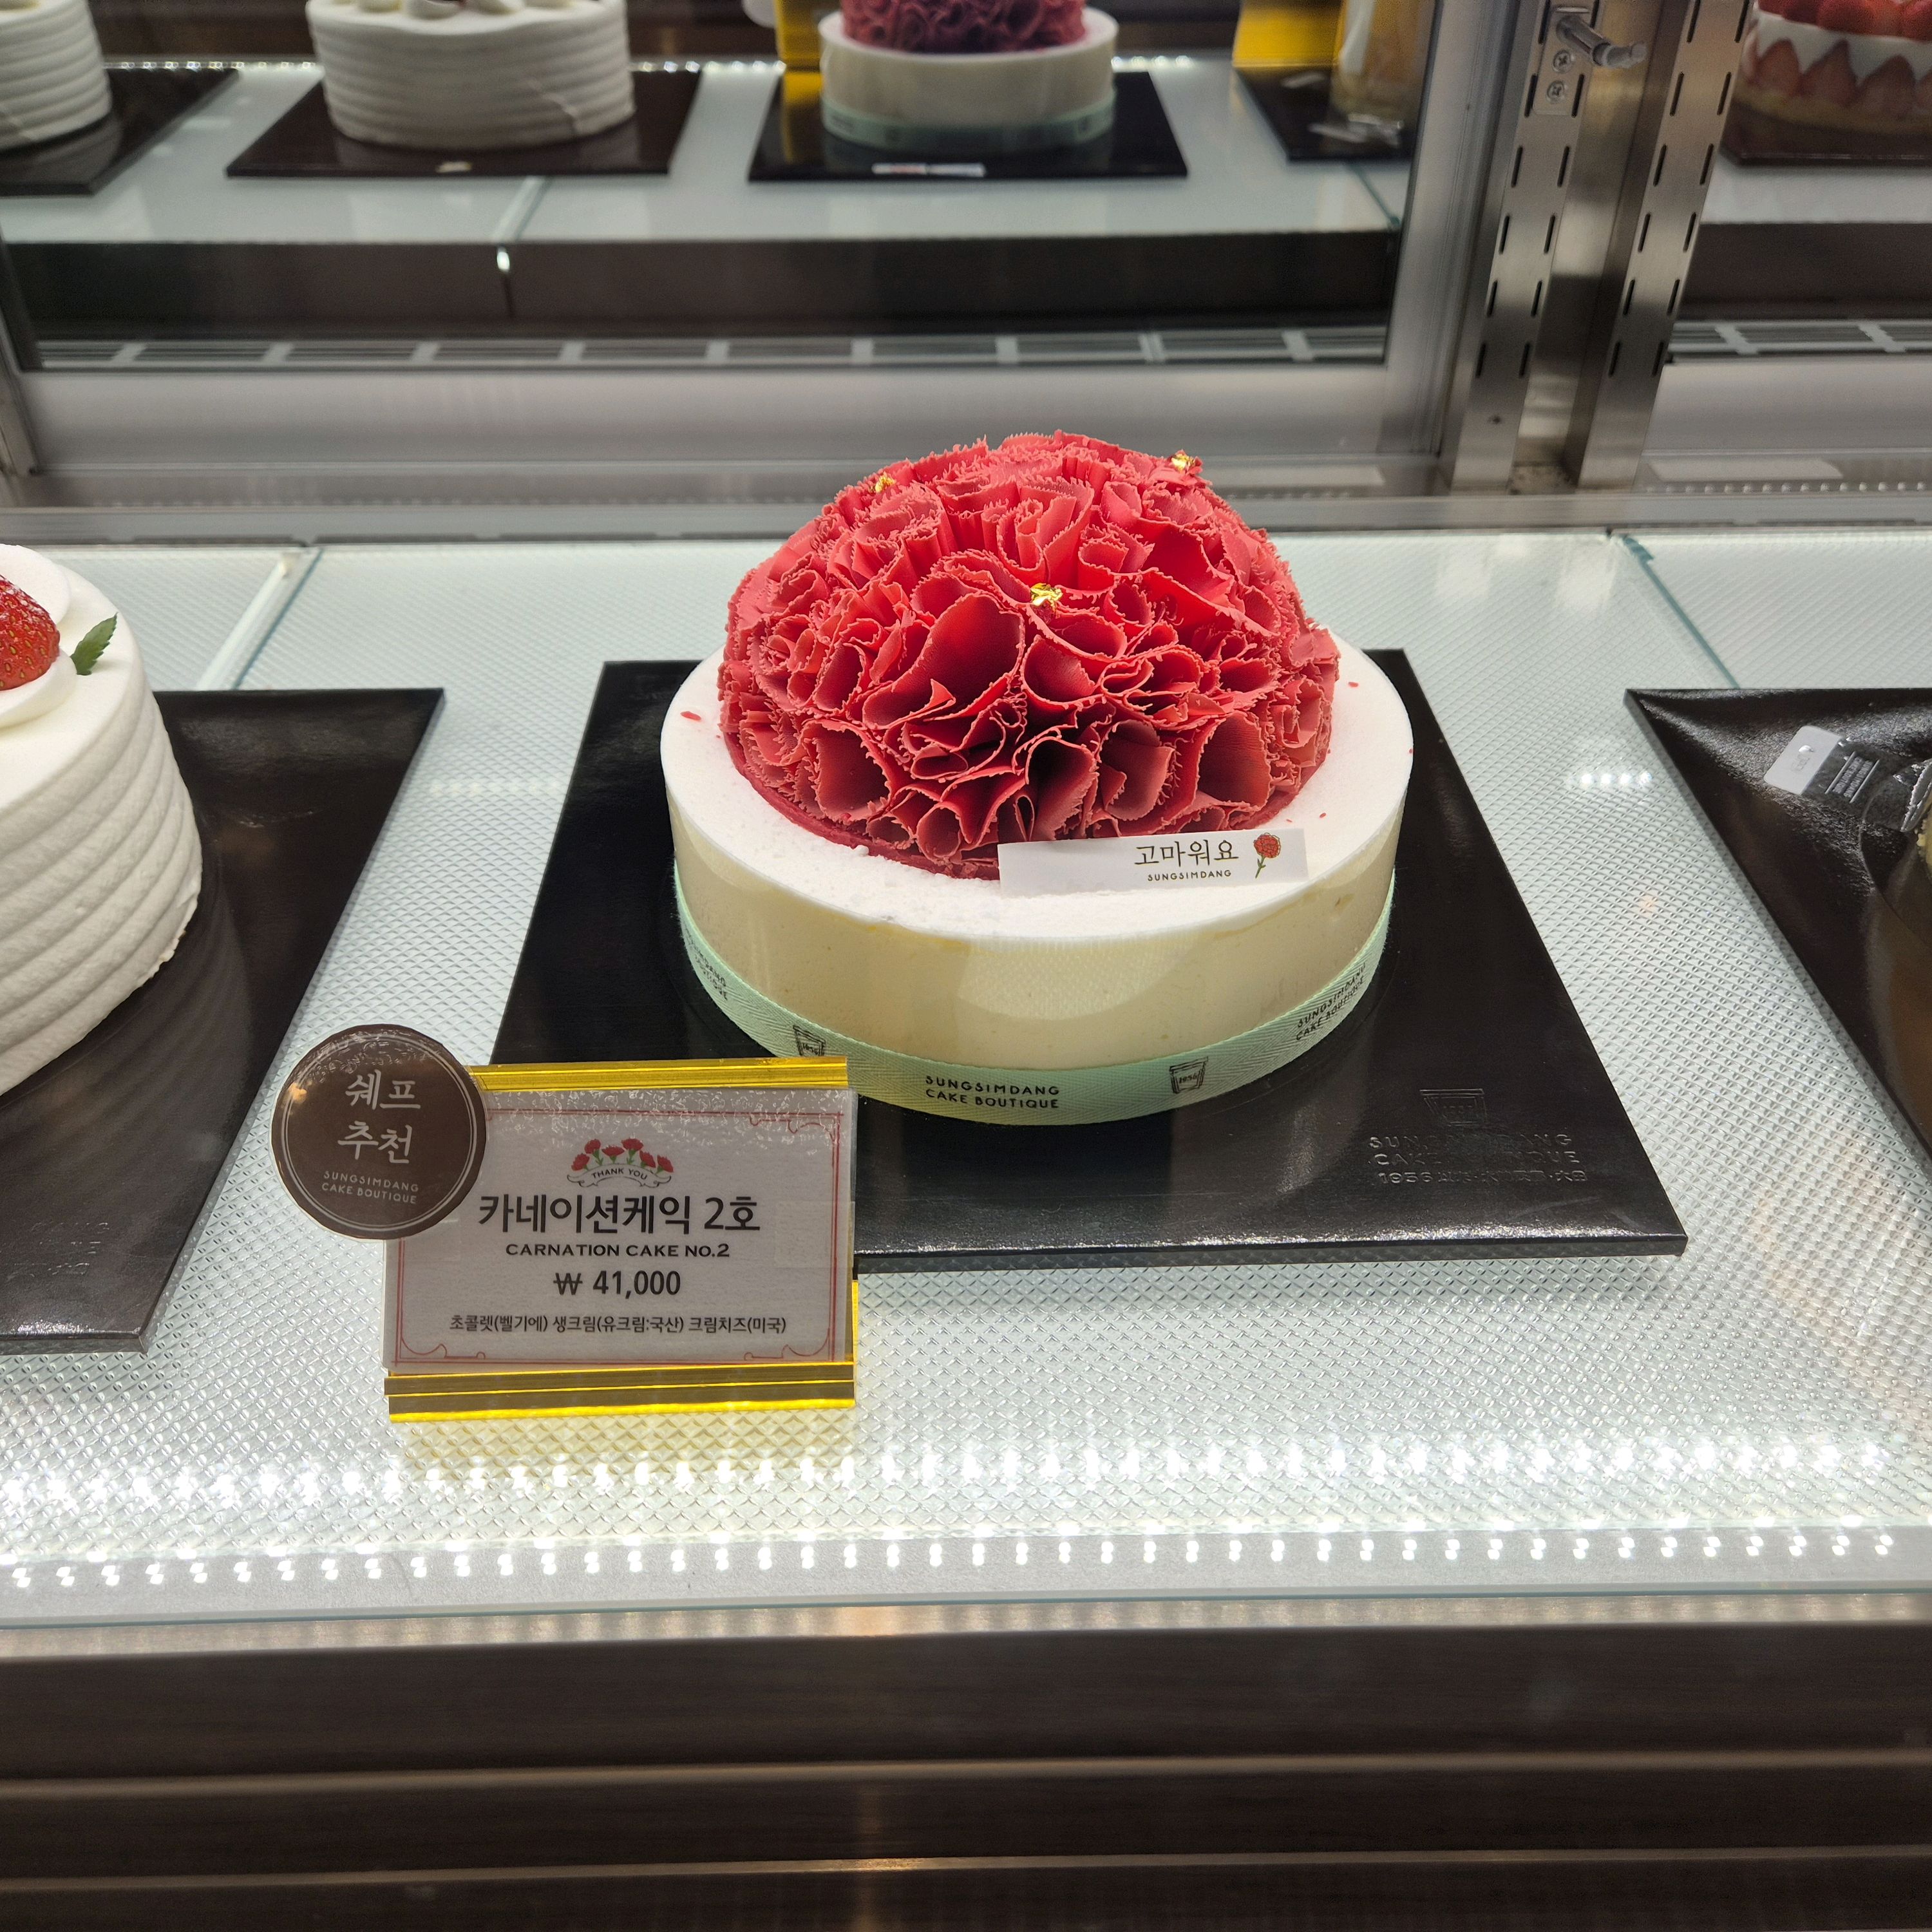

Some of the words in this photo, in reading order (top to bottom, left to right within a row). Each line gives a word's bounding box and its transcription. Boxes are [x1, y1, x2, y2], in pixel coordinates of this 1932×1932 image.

[1134, 839, 1239, 867] 고마워요
[1148, 869, 1231, 882] SUNGSIMDANG
[345, 1068, 421, 1110] 쉐프
[925, 1075, 1059, 1095] SUNGSIMDANG
[925, 1088, 968, 1104] CAKE
[975, 1095, 1059, 1109] BOUTIQUE
[337, 1120, 413, 1164] 추천
[323, 1170, 419, 1192] SUNGSIMDANG
[591, 1168, 624, 1179] THANK
[629, 1169, 648, 1180] YOU
[321, 1182, 353, 1195] CAKE
[357, 1186, 417, 1204] BOUTIQUE
[478, 1194, 691, 1235] 카네이션케익
[704, 1196, 761, 1231] 2호
[506, 1244, 620, 1256] CARNATION
[625, 1244, 679, 1256] CAKE
[684, 1243, 730, 1257] NO.2
[553, 1273, 583, 1295] ₩
[593, 1270, 681, 1299] 41,000
[450, 1314, 548, 1332] 초콜렛(벨기에)
[553, 1316, 684, 1333] 생크림(유크림:국산)
[688, 1317, 786, 1334] 크림치즈(미국)
